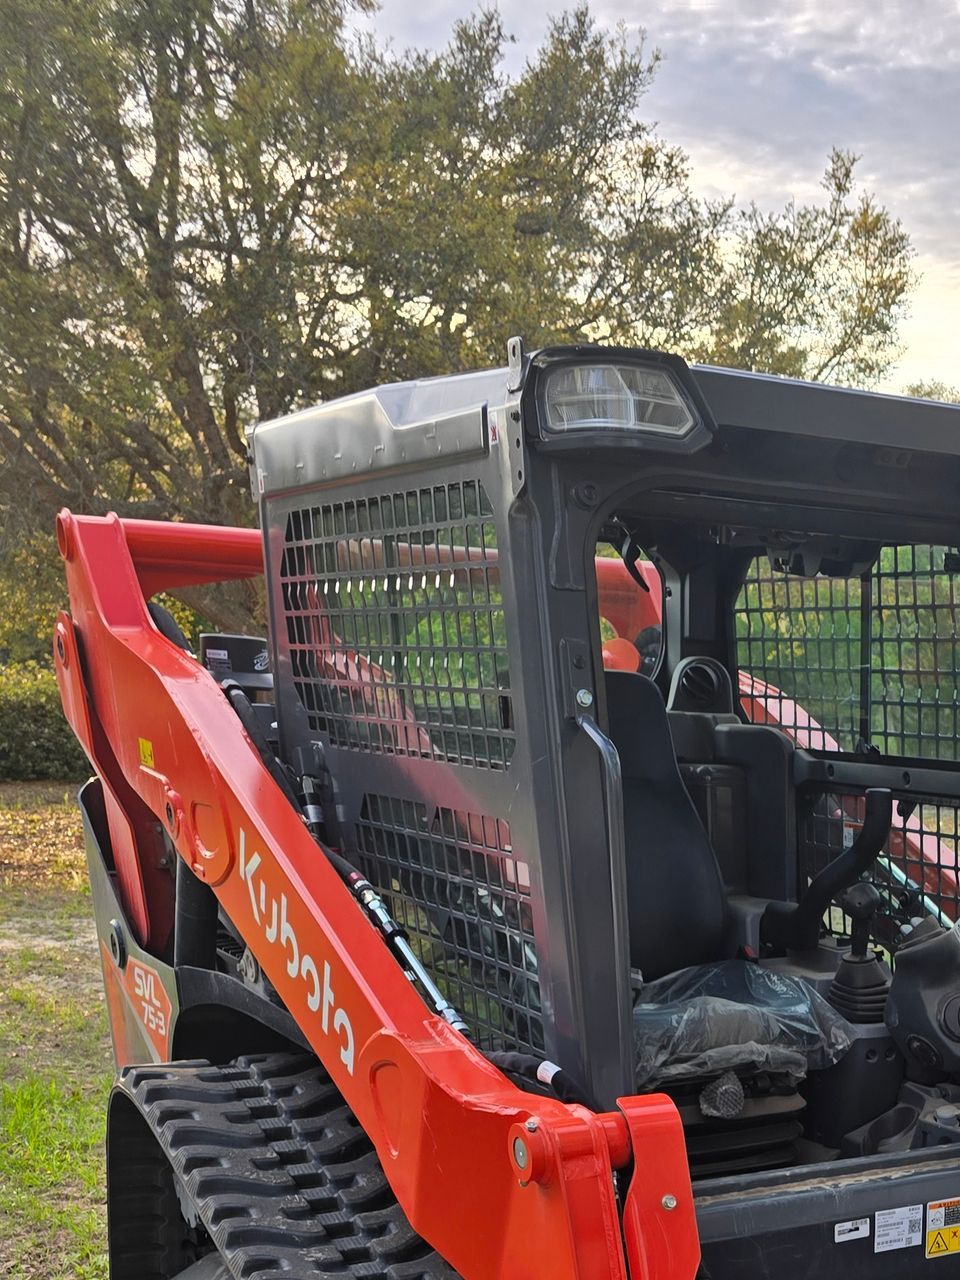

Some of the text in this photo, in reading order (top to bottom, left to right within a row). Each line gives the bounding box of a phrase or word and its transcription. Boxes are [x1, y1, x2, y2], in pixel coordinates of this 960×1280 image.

[239, 827, 354, 1077] Kubota
[134, 966, 161, 1008] SVL
[141, 1000, 166, 1038] 75-3
